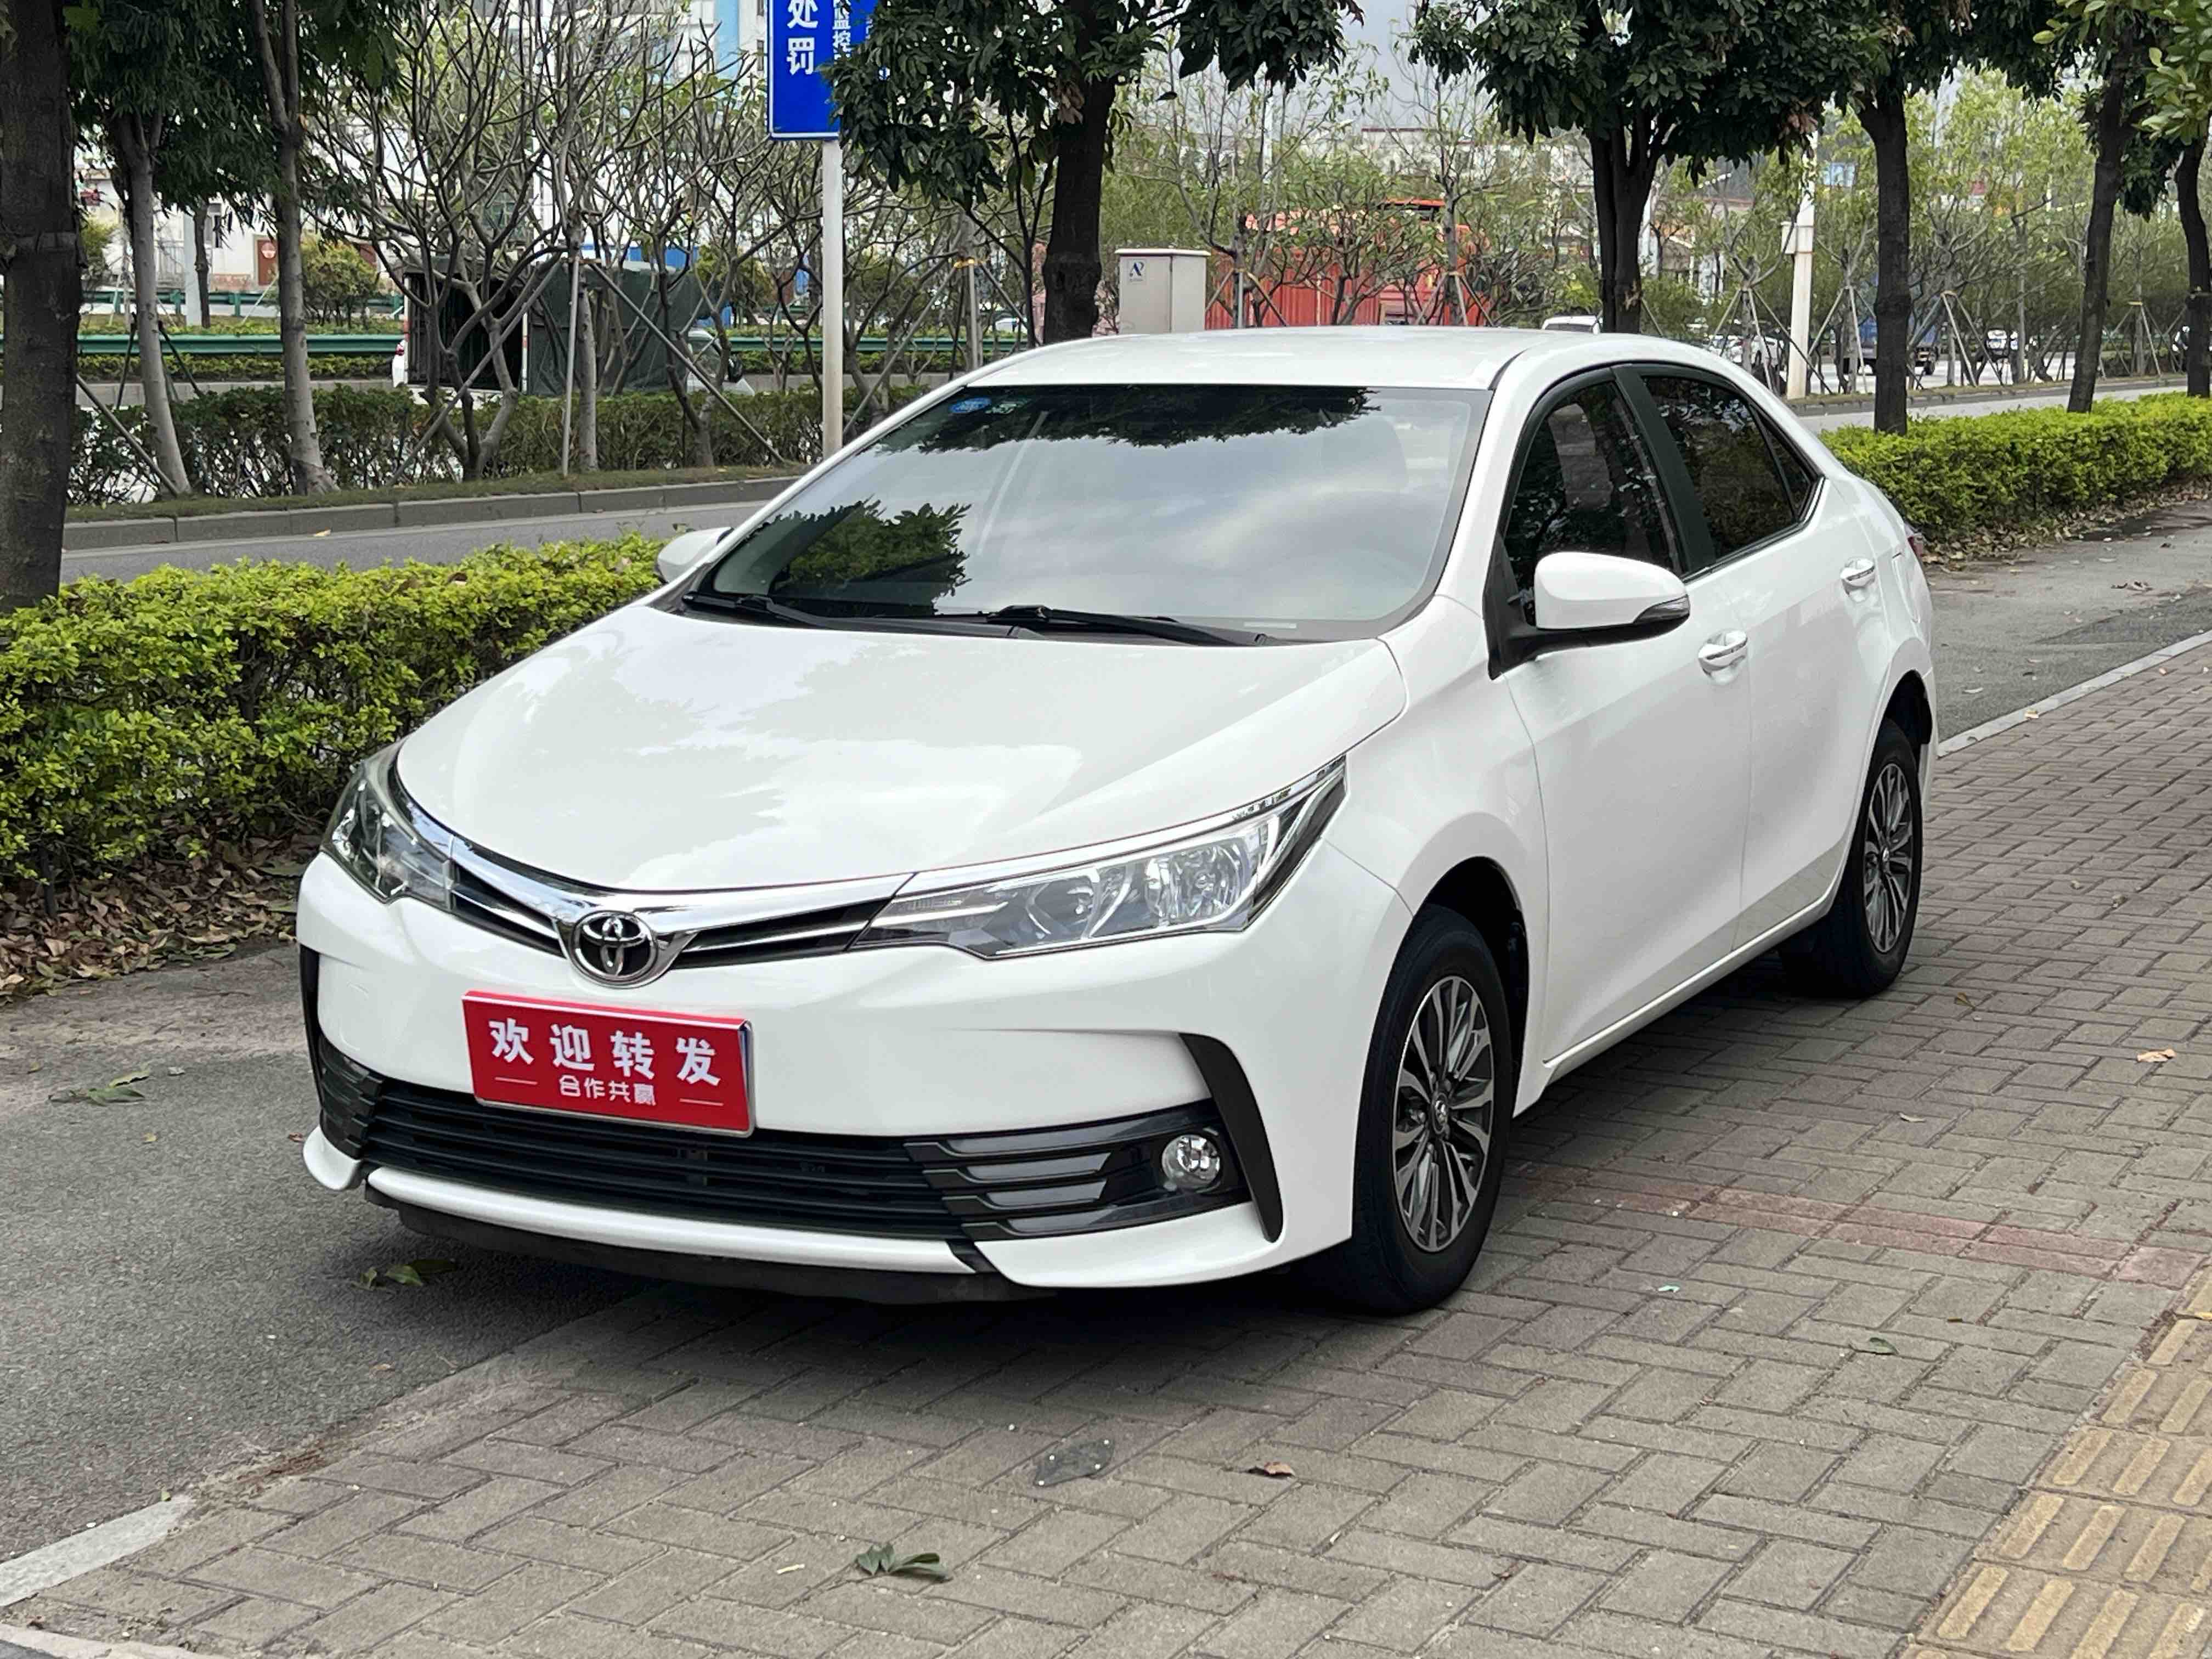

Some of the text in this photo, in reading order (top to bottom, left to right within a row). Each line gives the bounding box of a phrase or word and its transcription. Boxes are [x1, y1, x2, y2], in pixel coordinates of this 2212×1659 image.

[787, 0, 818, 75] 处罚
[488, 1018, 720, 1086] 欢迎转发
[559, 1074, 657, 1106] 合作共赢
